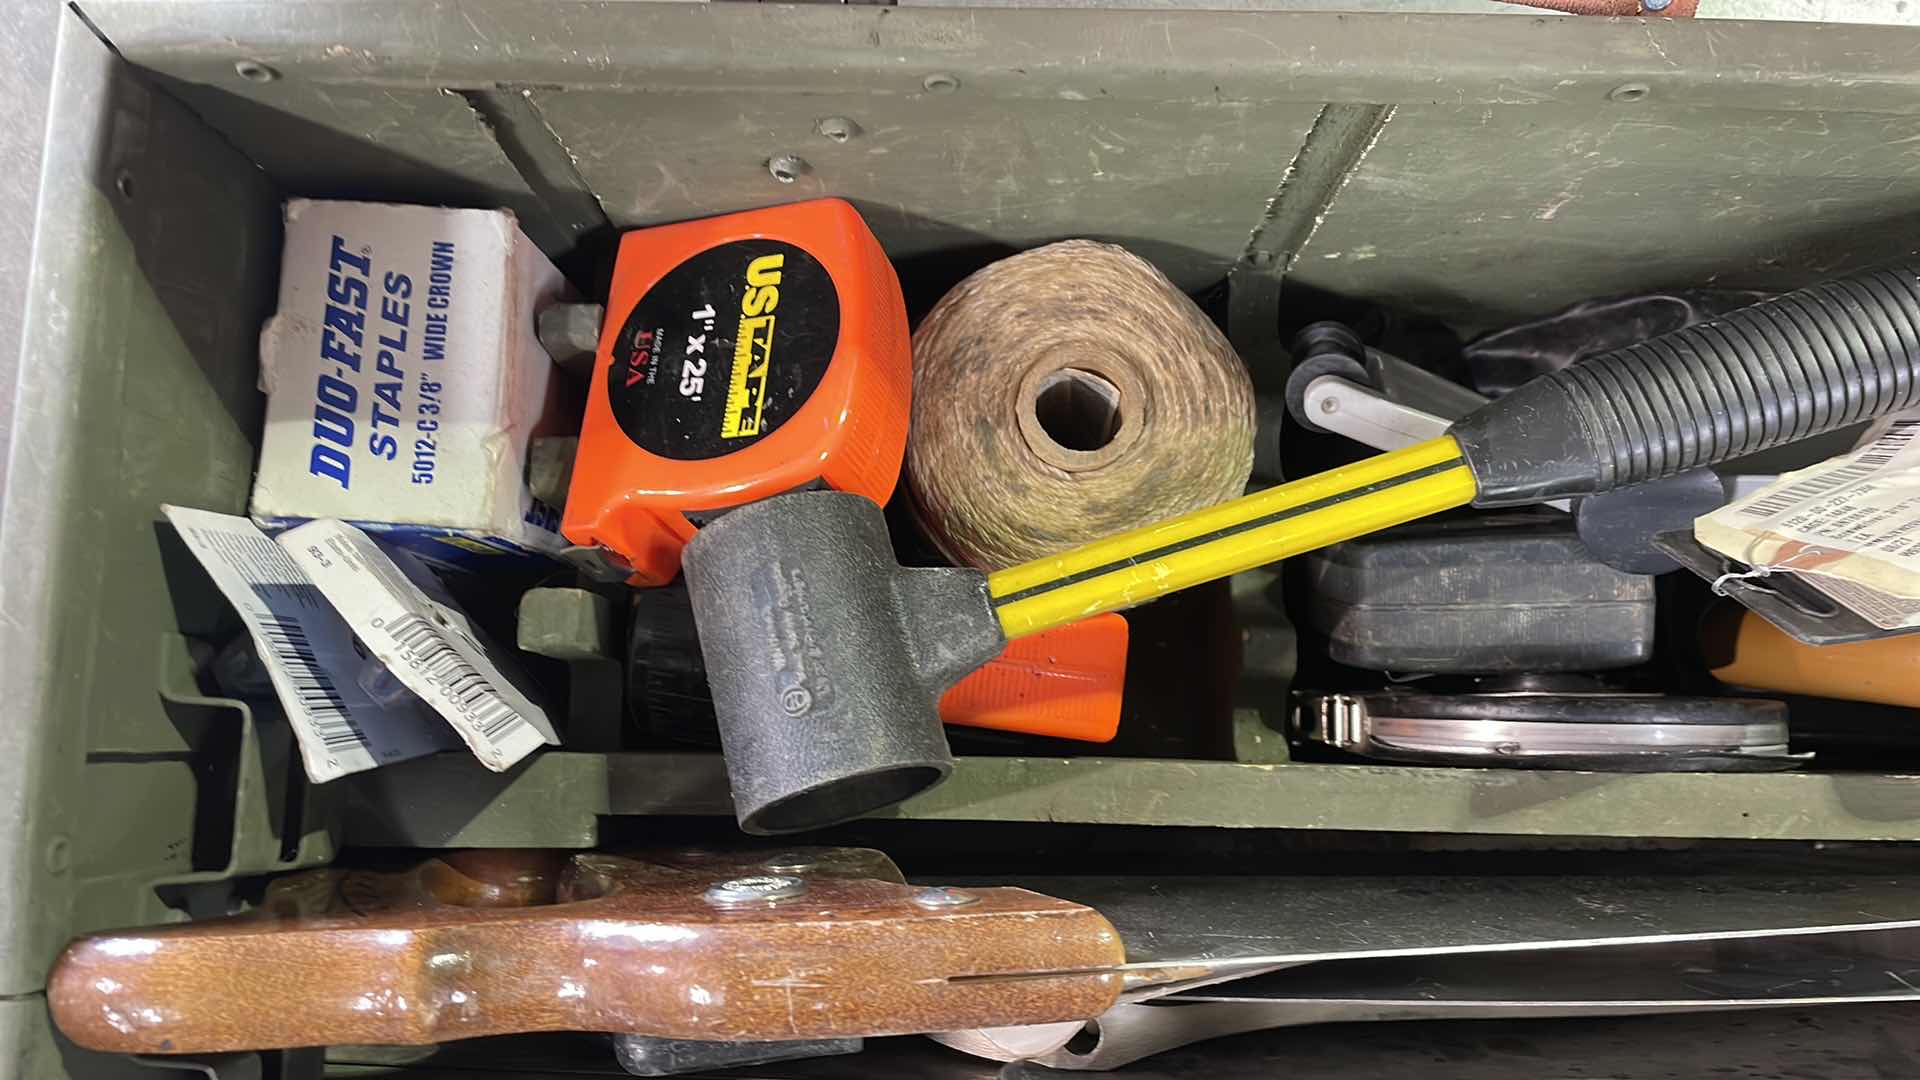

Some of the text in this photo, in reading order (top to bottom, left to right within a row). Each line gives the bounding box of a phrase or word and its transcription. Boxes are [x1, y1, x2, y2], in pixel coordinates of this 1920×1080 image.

[426, 241, 455, 309] CROWN
[369, 271, 412, 461] STAPLES
[423, 310, 448, 361] WIDE
[625, 330, 653, 388] USA
[412, 419, 439, 484] 5012-C
